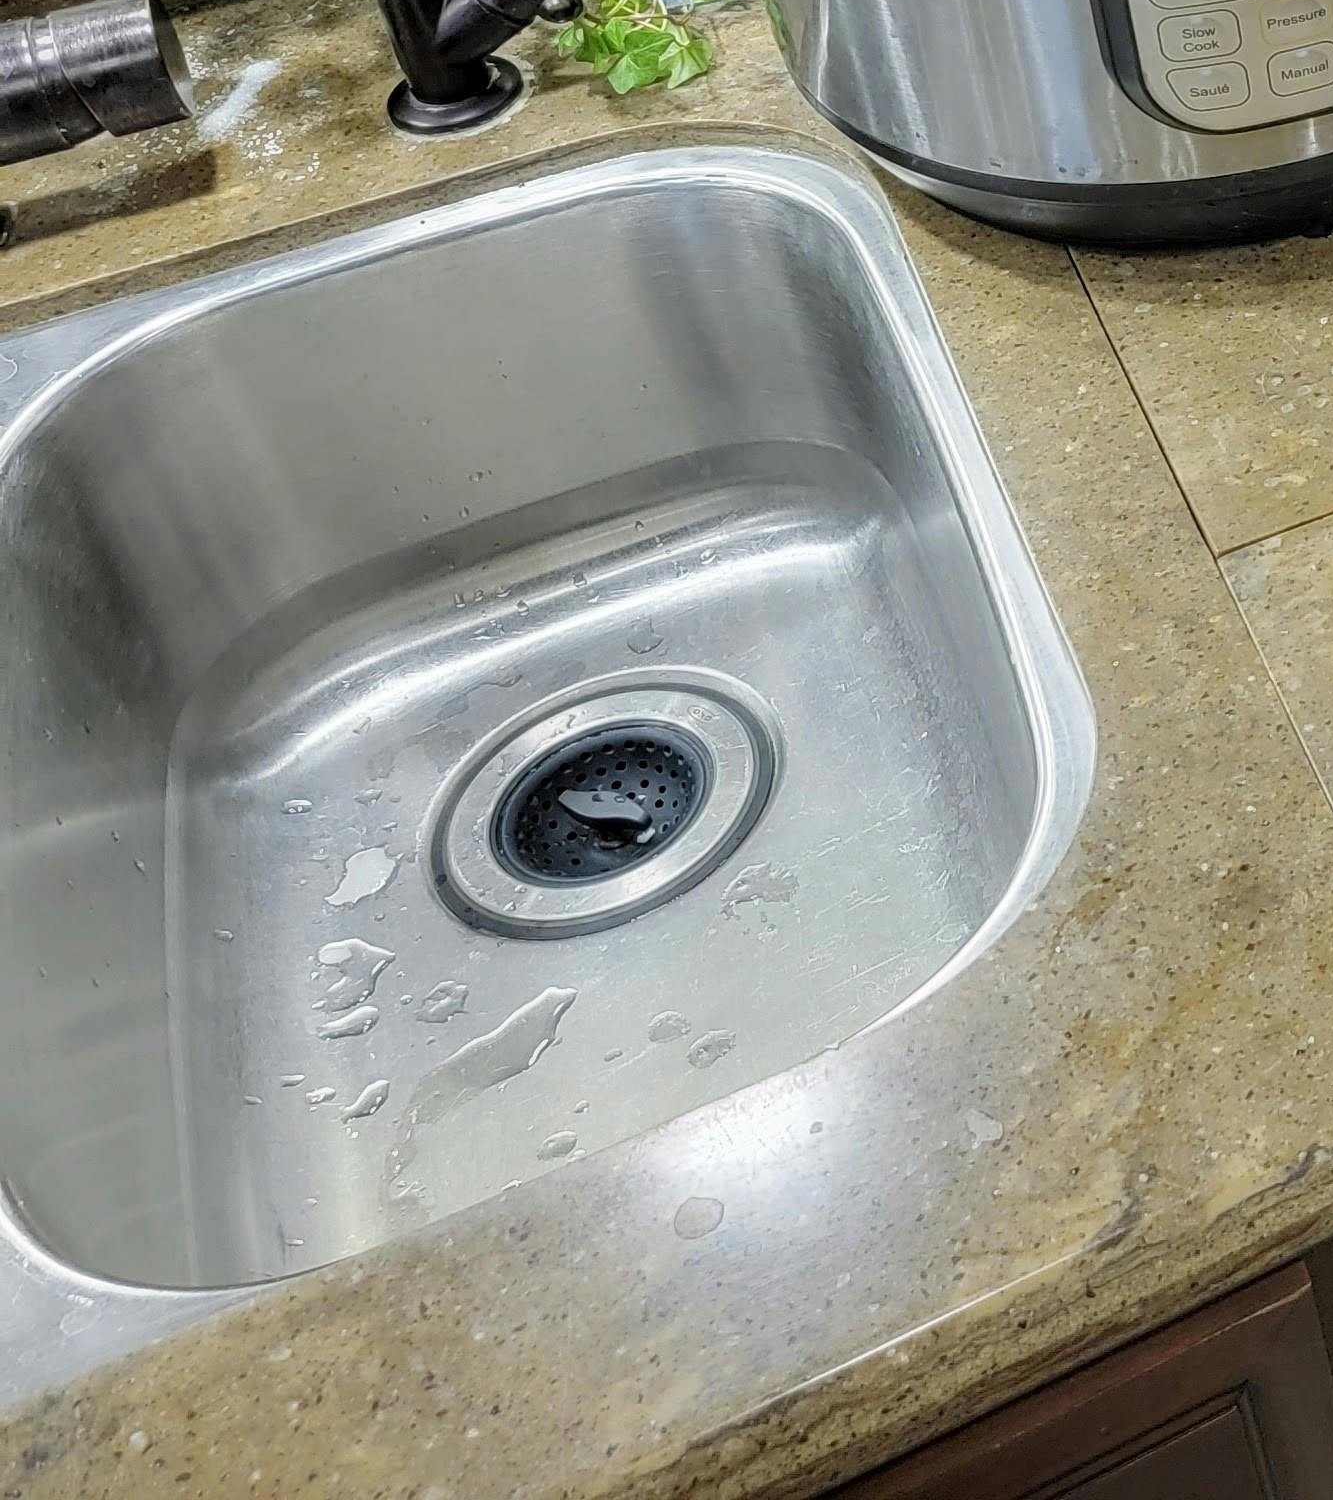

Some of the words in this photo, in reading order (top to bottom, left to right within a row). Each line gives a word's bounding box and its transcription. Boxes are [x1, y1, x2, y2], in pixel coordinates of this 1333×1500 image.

[1266, 8, 1327, 30] Pressure
[1181, 27, 1217, 40] Slow
[1183, 40, 1220, 54] Cook
[1281, 60, 1329, 81] Manual
[1189, 83, 1232, 98] Sauté
